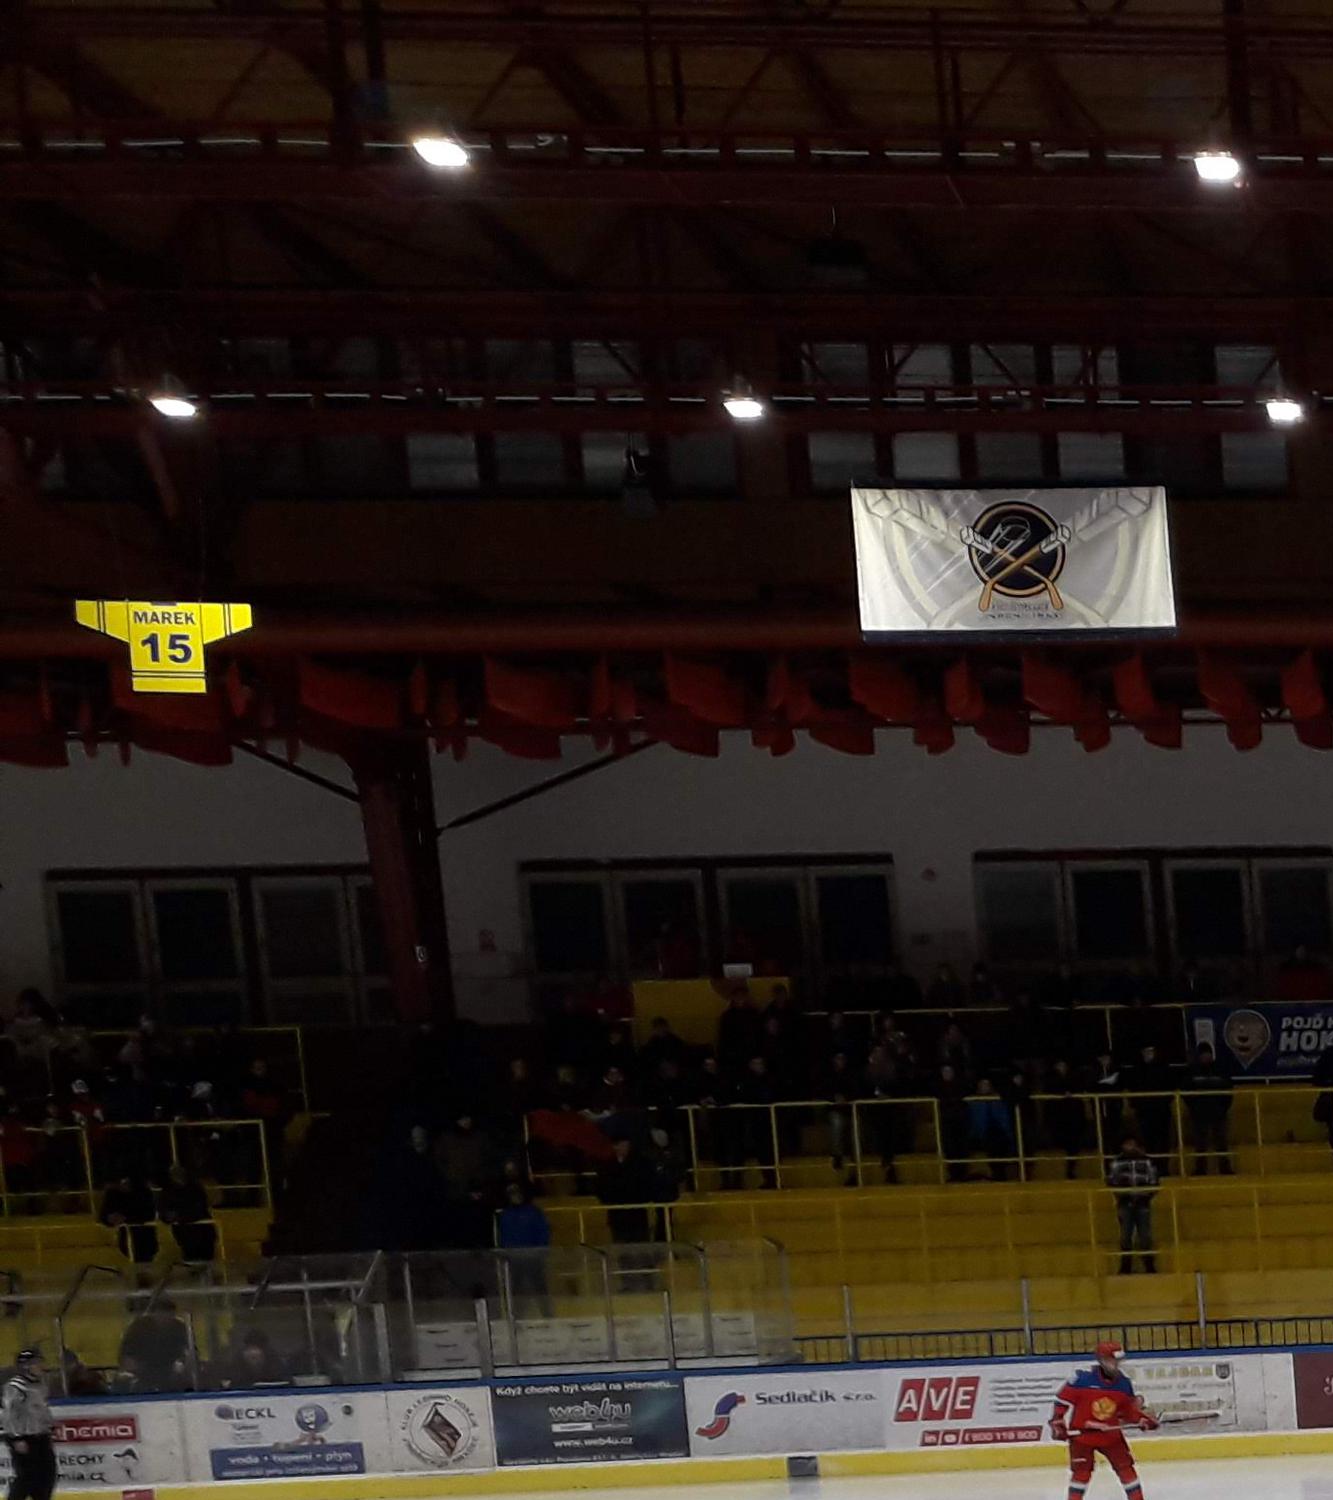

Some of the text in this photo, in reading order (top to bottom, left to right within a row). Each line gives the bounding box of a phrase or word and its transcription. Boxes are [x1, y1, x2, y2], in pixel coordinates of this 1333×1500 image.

[133, 611, 196, 625] MAREK
[141, 633, 192, 663] 15
[897, 1385, 976, 1413] AVE
[235, 1407, 276, 1420] ECKL
